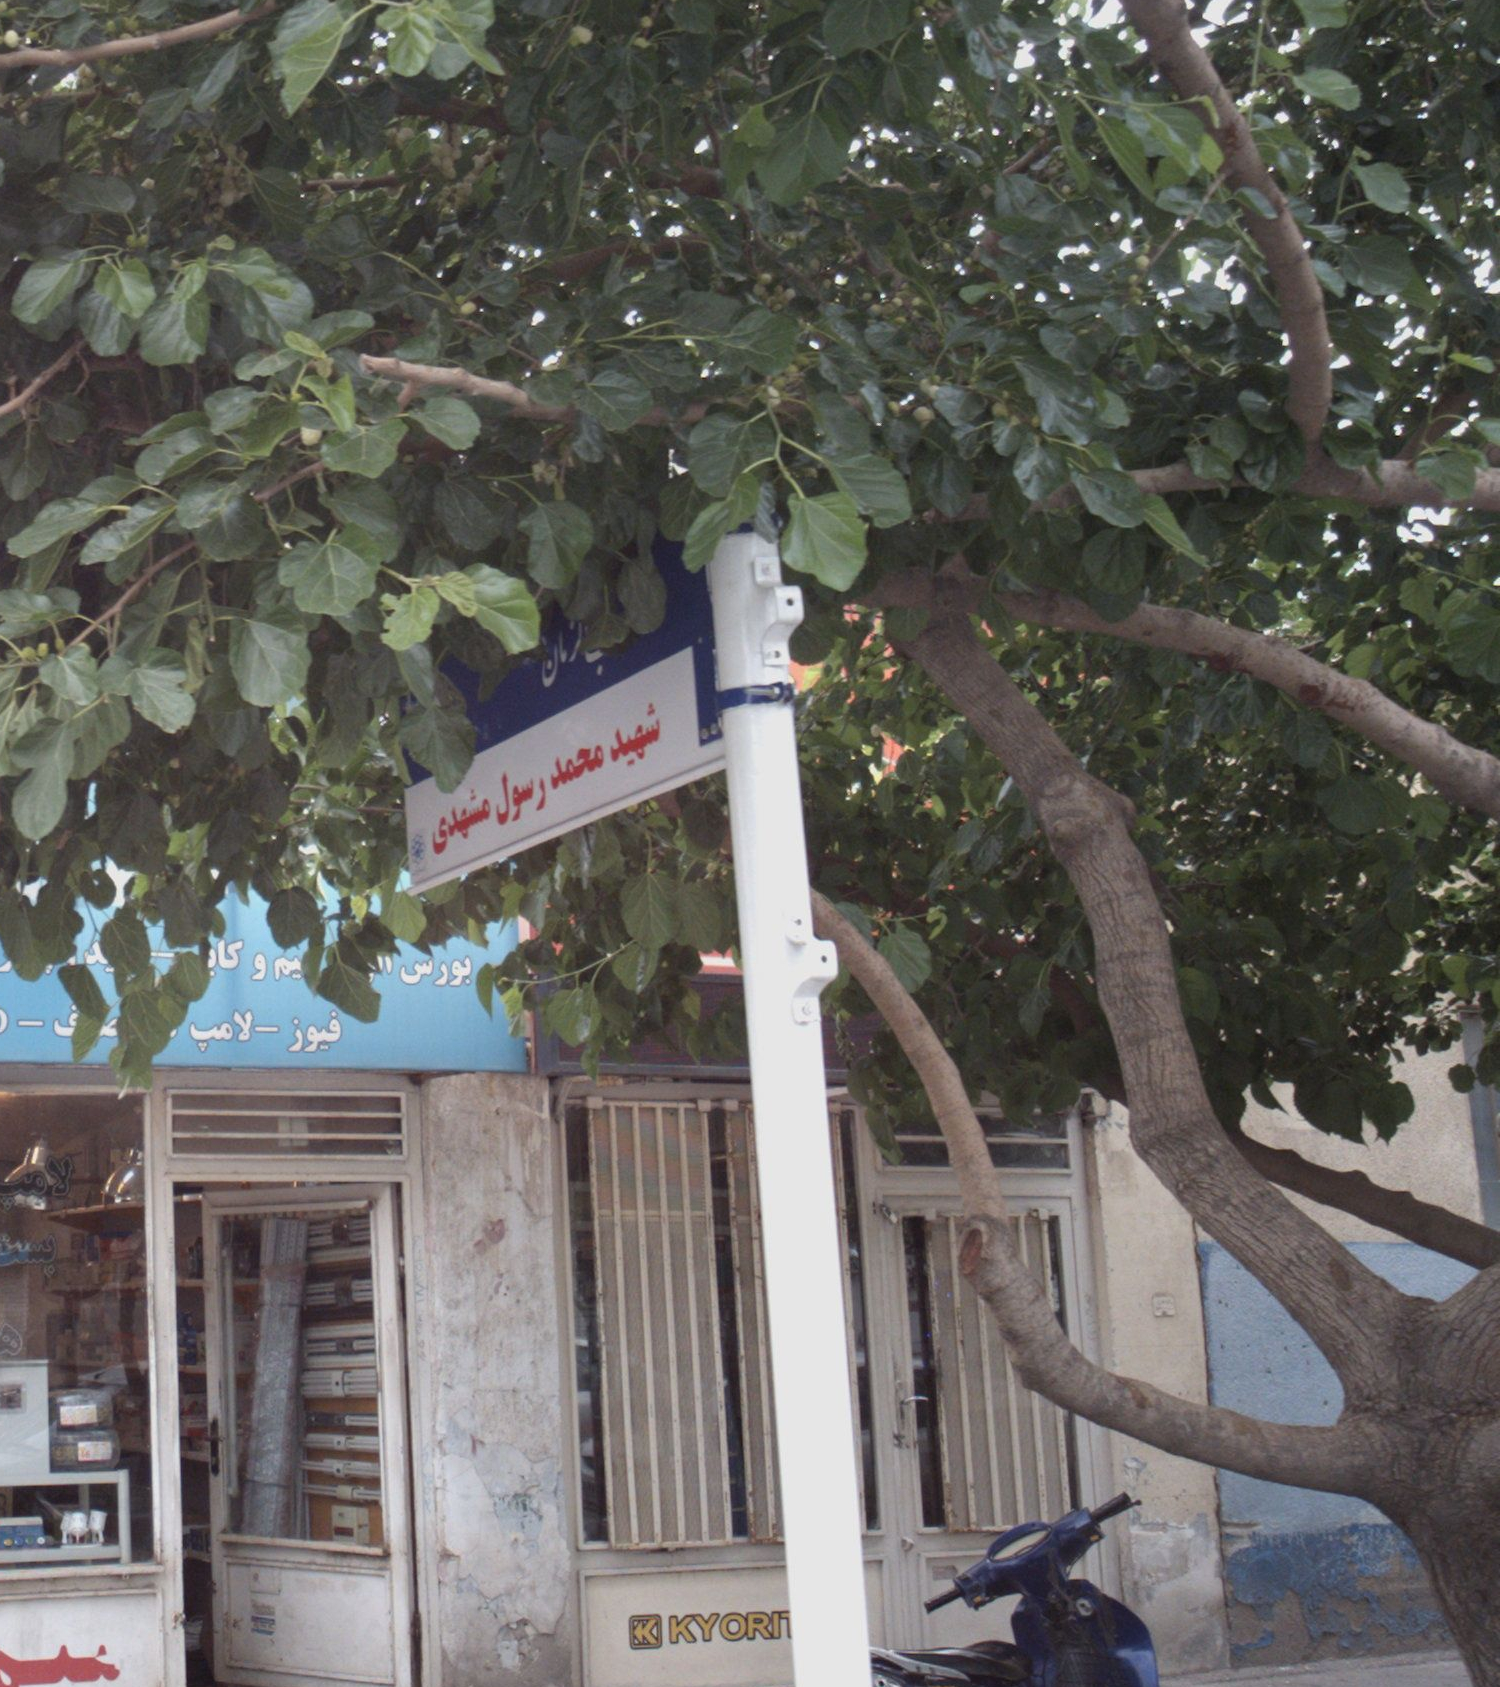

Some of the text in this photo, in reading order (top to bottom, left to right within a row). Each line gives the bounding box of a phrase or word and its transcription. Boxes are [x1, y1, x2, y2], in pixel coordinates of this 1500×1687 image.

[432, 702, 661, 855] شهید محمد رسول مشهدی
[207, 939, 244, 977] کاب
[400, 955, 473, 987] بورس
[287, 1010, 342, 1052] فیوز
